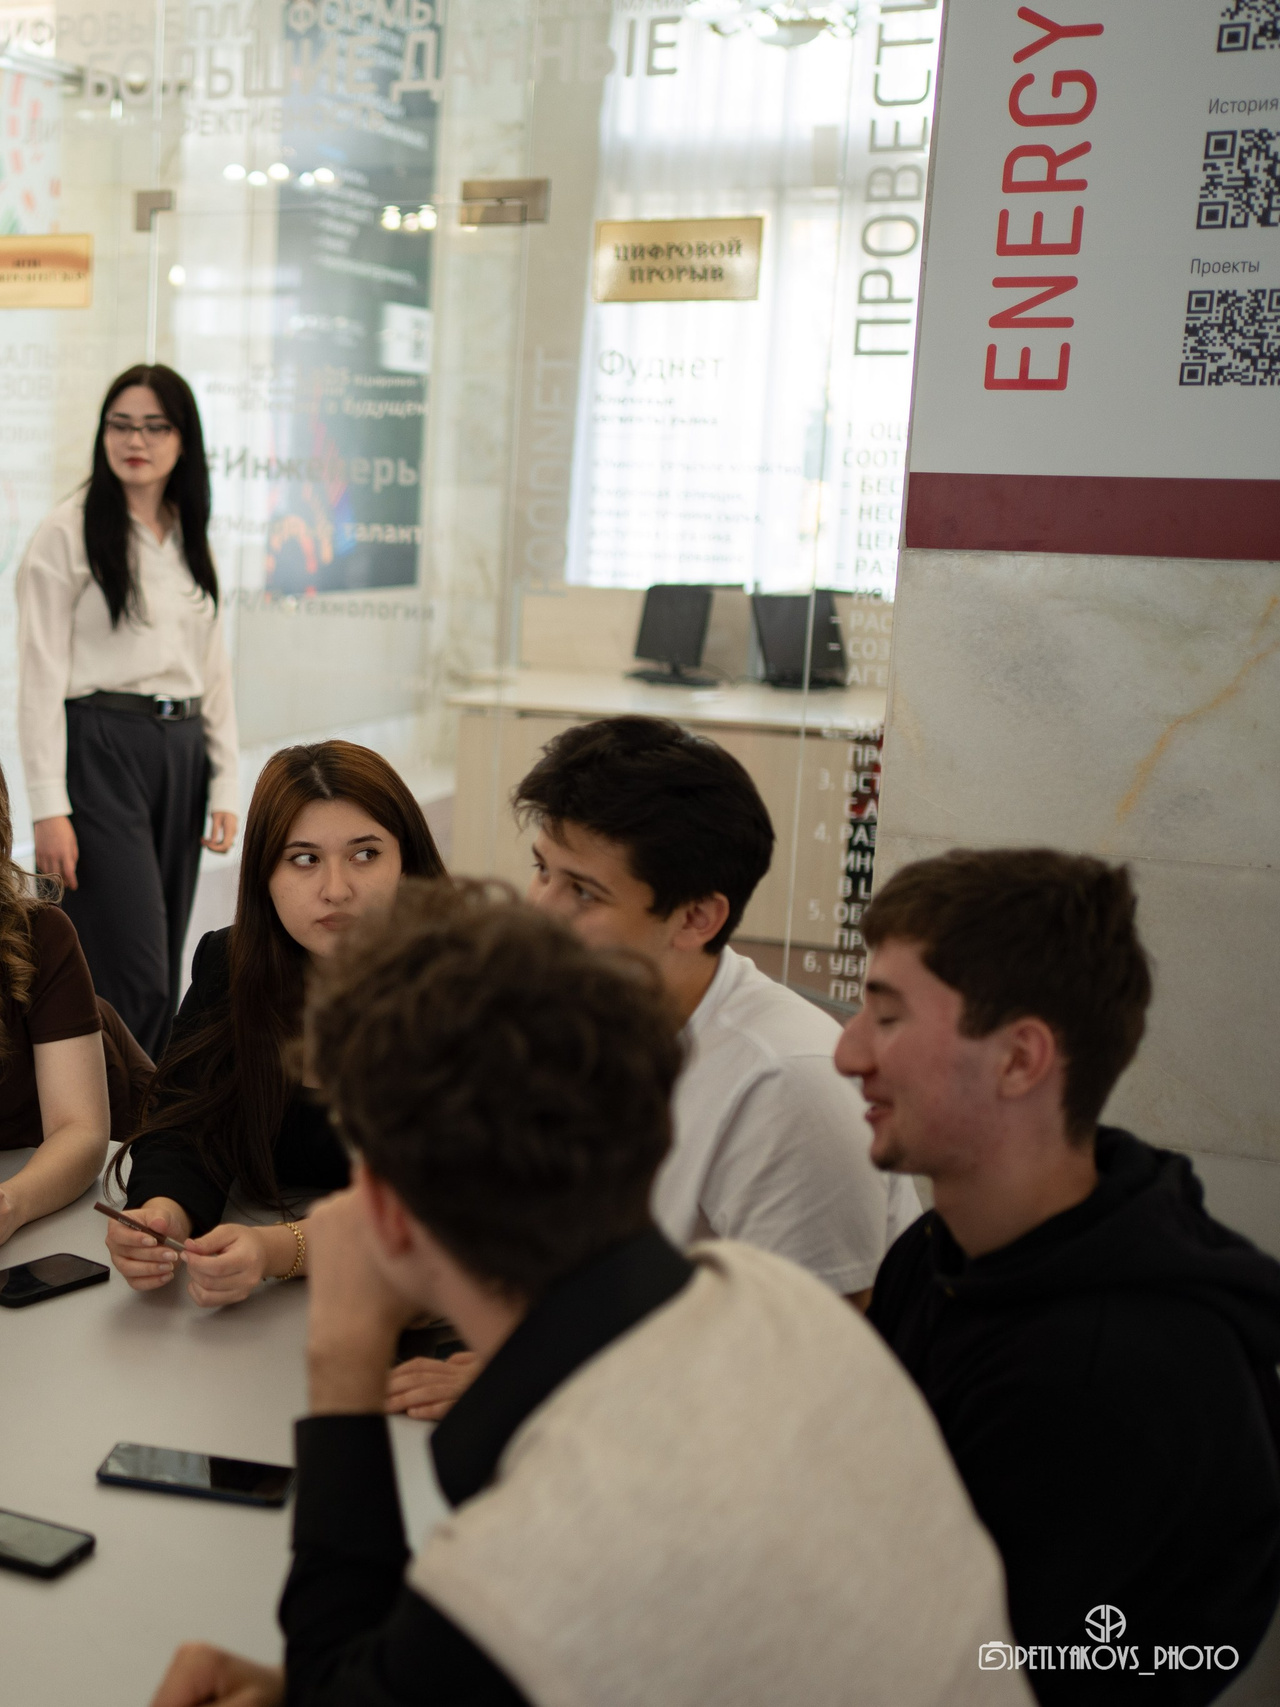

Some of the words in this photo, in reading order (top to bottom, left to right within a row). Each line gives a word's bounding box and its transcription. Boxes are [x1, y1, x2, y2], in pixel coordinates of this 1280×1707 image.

[1208, 97, 1280, 116] История
[984, 5, 1105, 391] ENERGY
[613, 237, 743, 261] ЦИФРОВОЙ
[629, 264, 725, 285] ПРОРЫВ
[1190, 258, 1260, 277] Проекты
[597, 349, 724, 387] Фуднет
[870, 421, 907, 444] ОЦ
[848, 743, 883, 767] ПР
[840, 849, 873, 873] ИН
[833, 902, 868, 925] ОБ
[803, 952, 822, 974] 6.
[829, 980, 864, 1002] ПР
